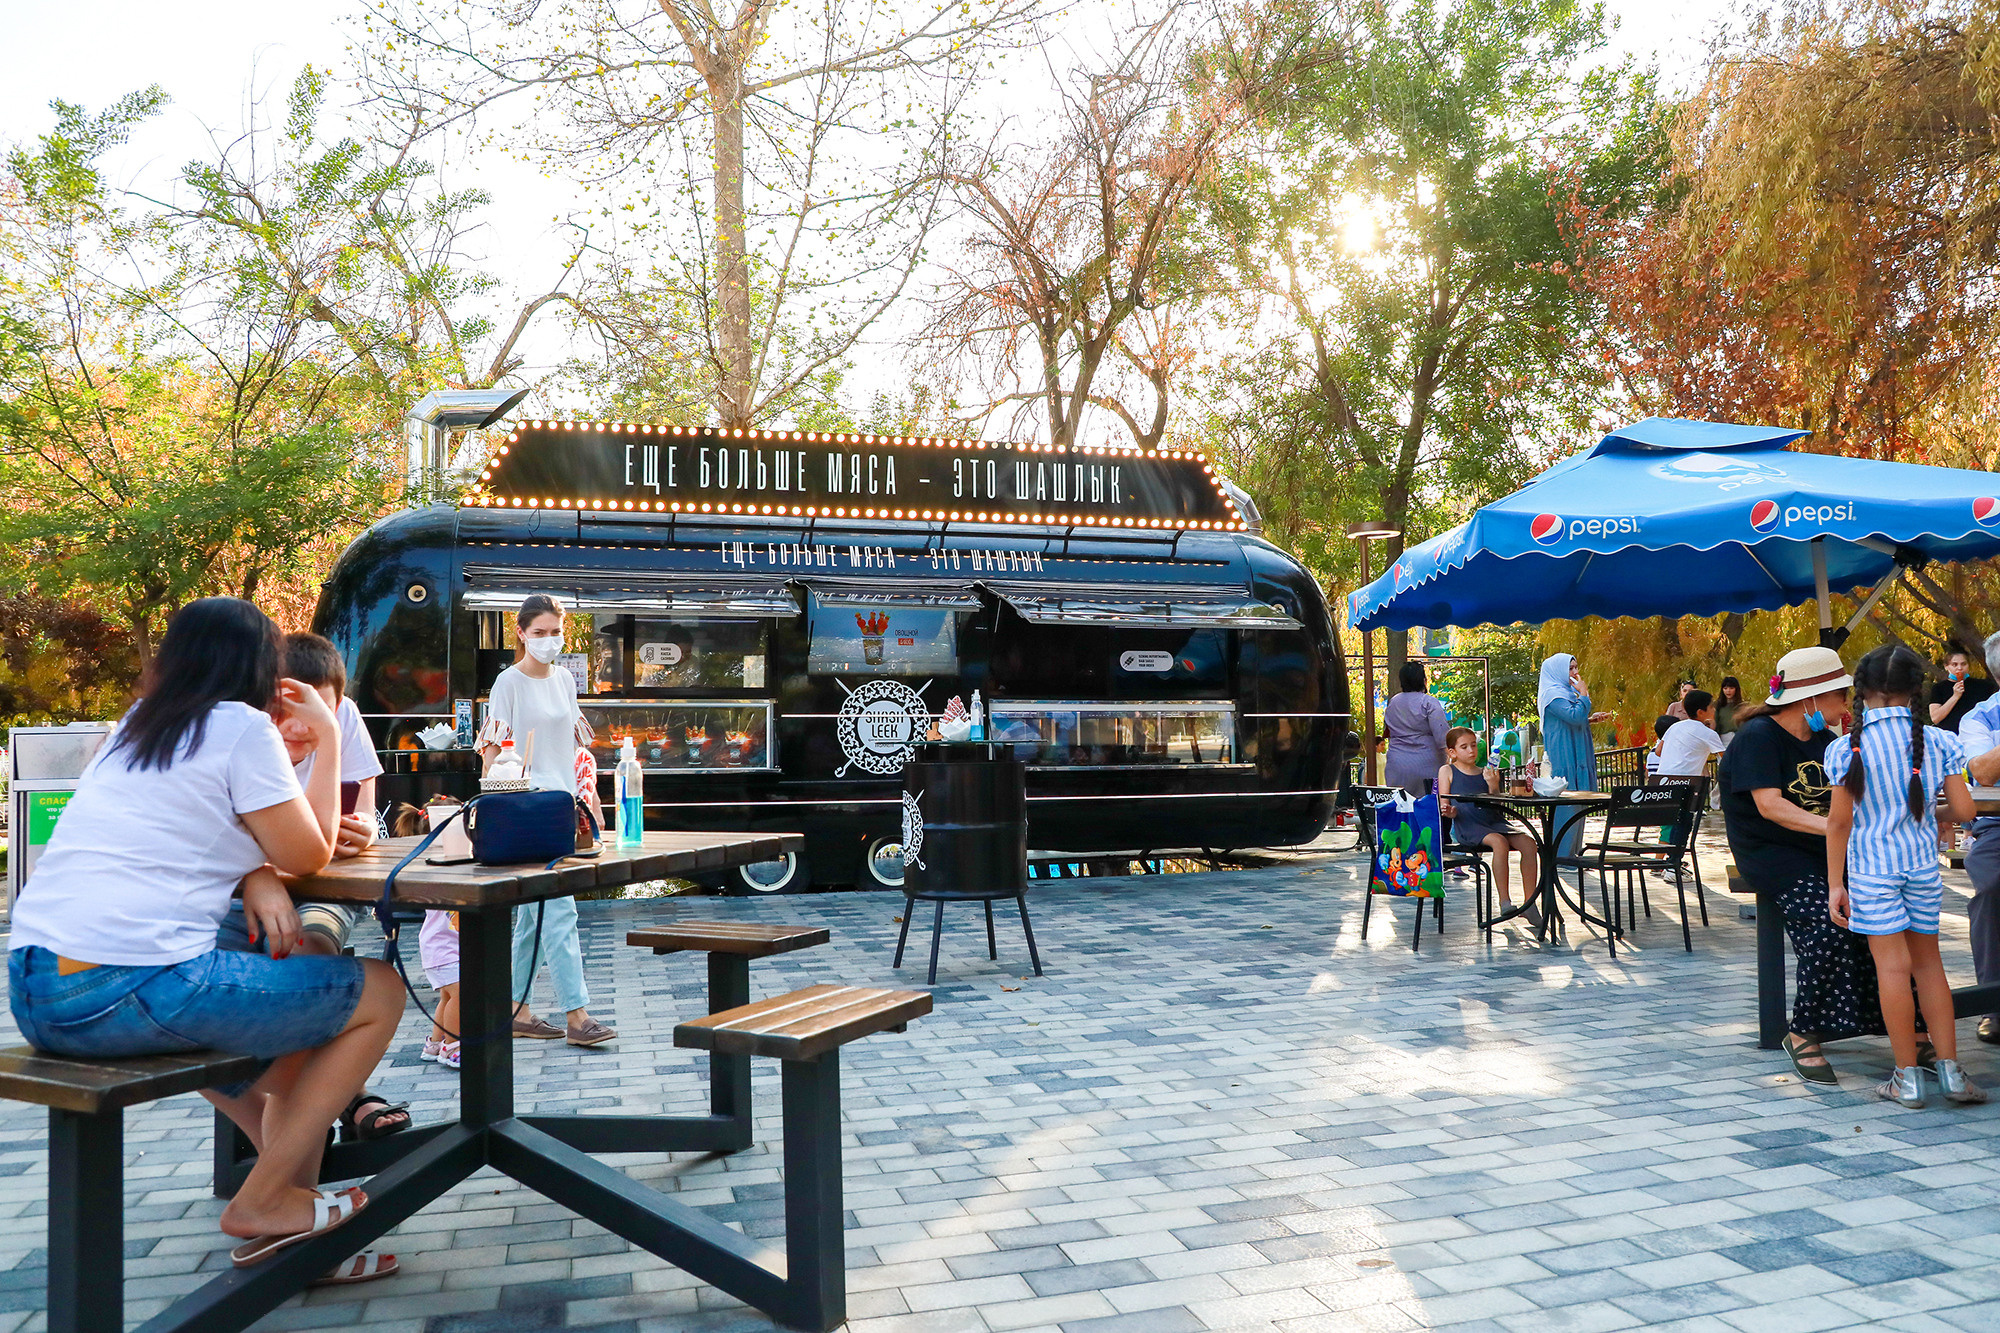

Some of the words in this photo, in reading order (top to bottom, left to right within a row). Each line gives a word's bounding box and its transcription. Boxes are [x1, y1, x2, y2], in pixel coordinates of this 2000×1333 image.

[625, 444, 678, 495] ЕЩЕ
[699, 447, 807, 492] БОЛЬШЕ
[827, 452, 897, 495] МЯСА
[953, 457, 996, 500] ЭТО
[1015, 461, 1121, 504] ШАШЛЫК
[1784, 501, 1853, 527] pepsi
[1569, 516, 1638, 541] pepsi
[721, 541, 756, 569] ЕЩЕ
[767, 542, 838, 567] БОЛЬШЕ
[849, 545, 896, 569] МЯСА
[930, 547, 961, 571] ЭТО
[970, 549, 1044, 572] ШАШЛЫК
[871, 724, 898, 738] LEEK
[1643, 790, 1673, 802] pepsi
